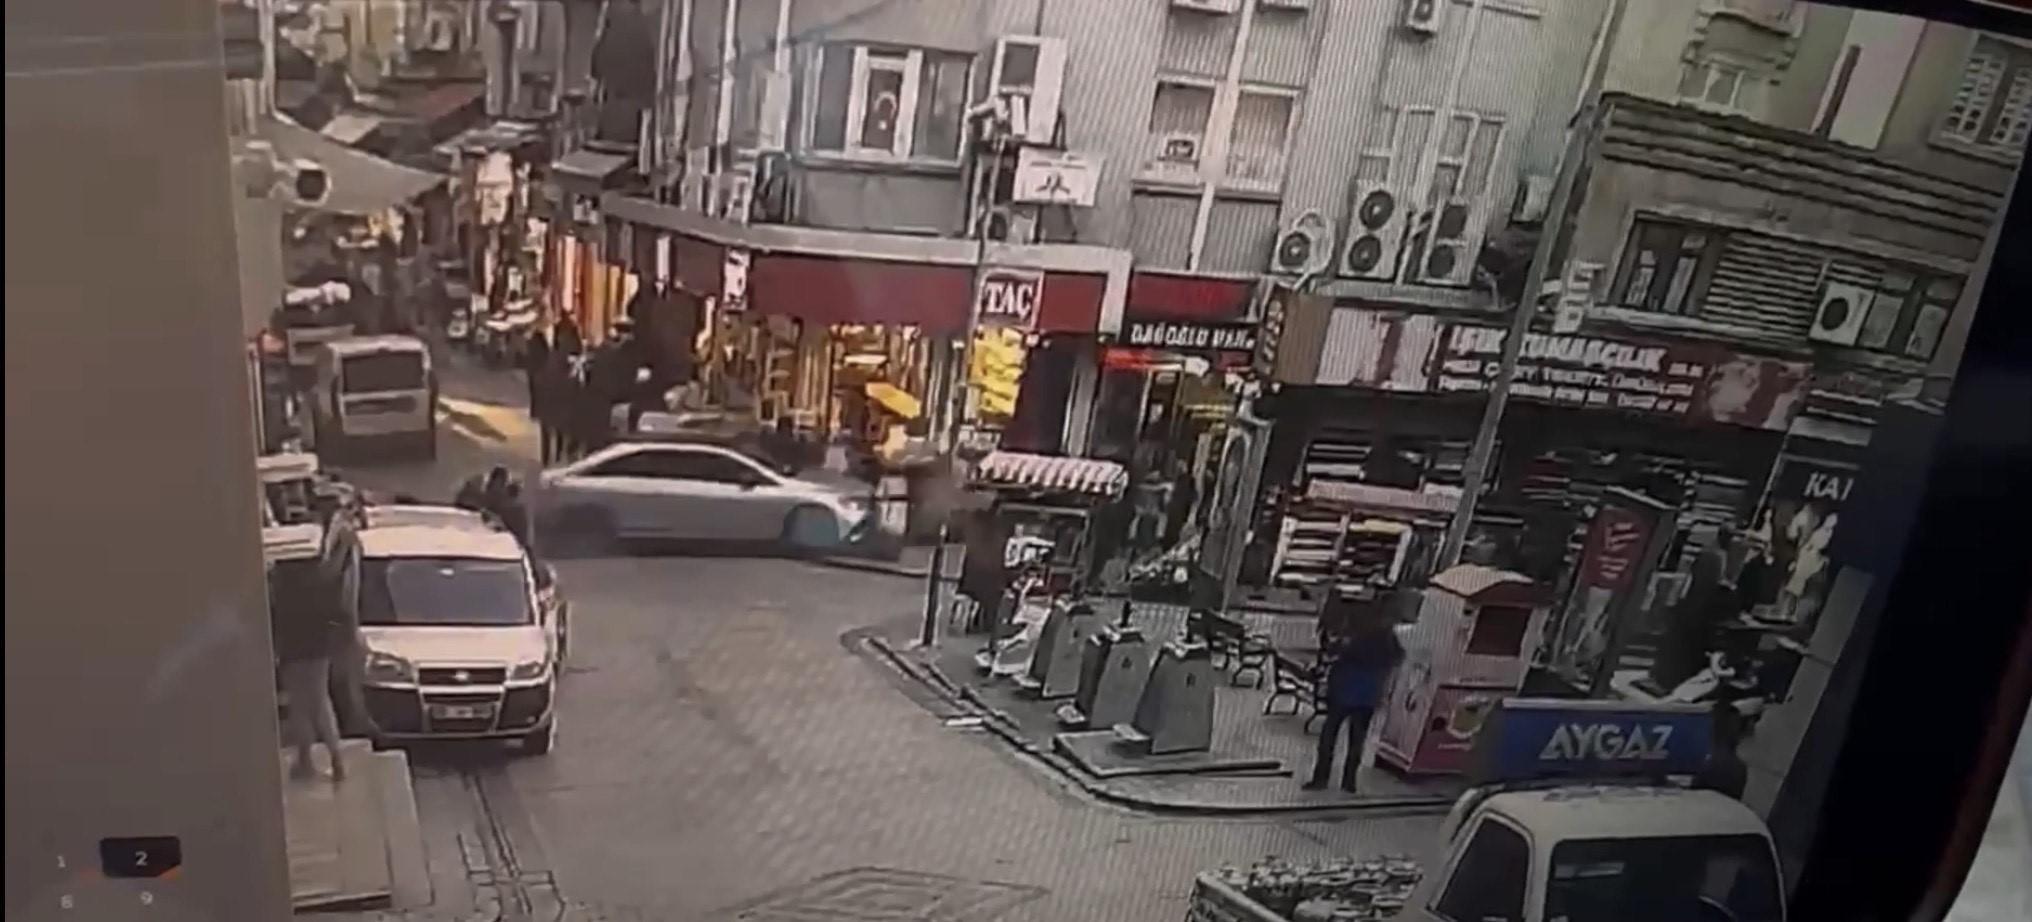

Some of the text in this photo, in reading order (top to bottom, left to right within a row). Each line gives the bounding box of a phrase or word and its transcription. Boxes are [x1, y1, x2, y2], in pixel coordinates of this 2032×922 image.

[985, 281, 1033, 320] TAÇ
[1538, 722, 1674, 760] AYGAZ
[57, 850, 149, 868] 1 2
[141, 891, 154, 906] 9
